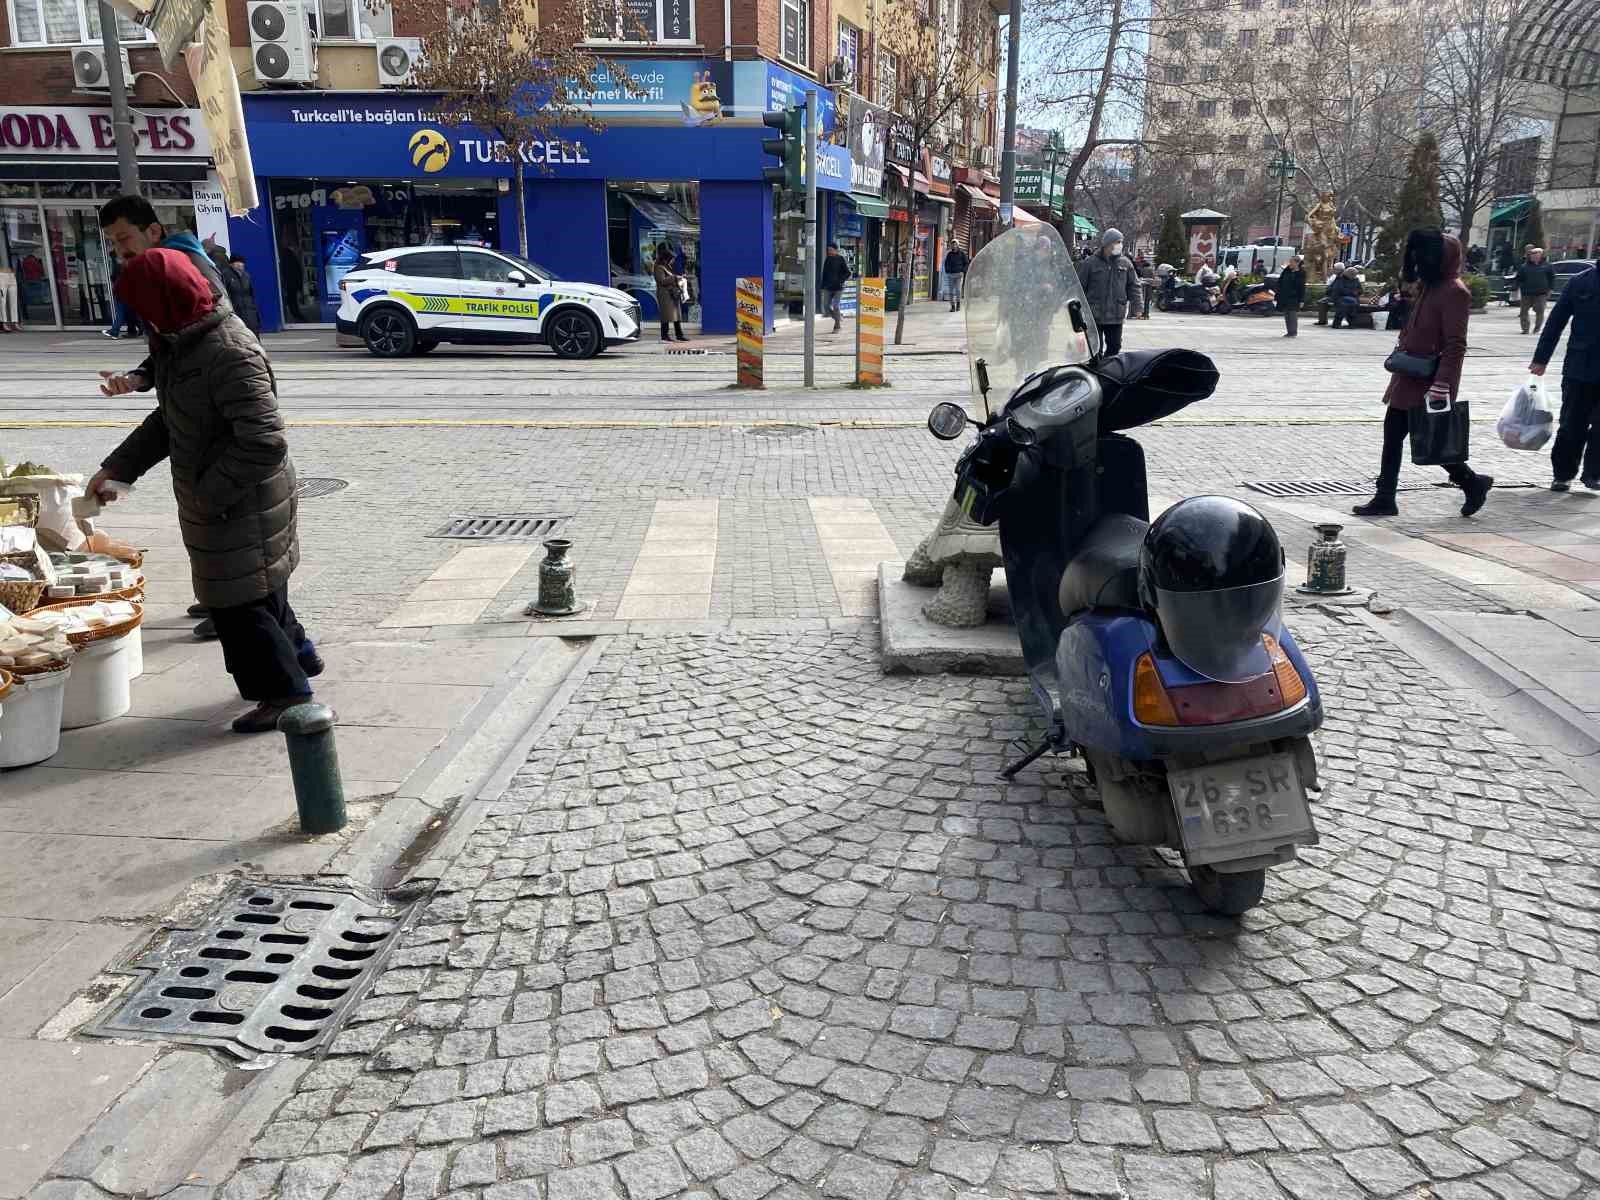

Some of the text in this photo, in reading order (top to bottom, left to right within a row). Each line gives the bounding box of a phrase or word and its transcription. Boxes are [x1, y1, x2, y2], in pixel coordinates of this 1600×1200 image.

[631, 70, 665, 84] evde
[365, 109, 415, 124] bağlan
[0, 114, 196, 150] ODA E-ES
[459, 140, 591, 164] TURKCELL
[1015, 175, 1041, 184] EMEN
[194, 190, 222, 203] Bayan
[1014, 186, 1037, 194] ARAT
[197, 203, 223, 216] Giyim
[466, 301, 534, 315] TRAFİK POLİSİ
[1245, 764, 1292, 796] SR
